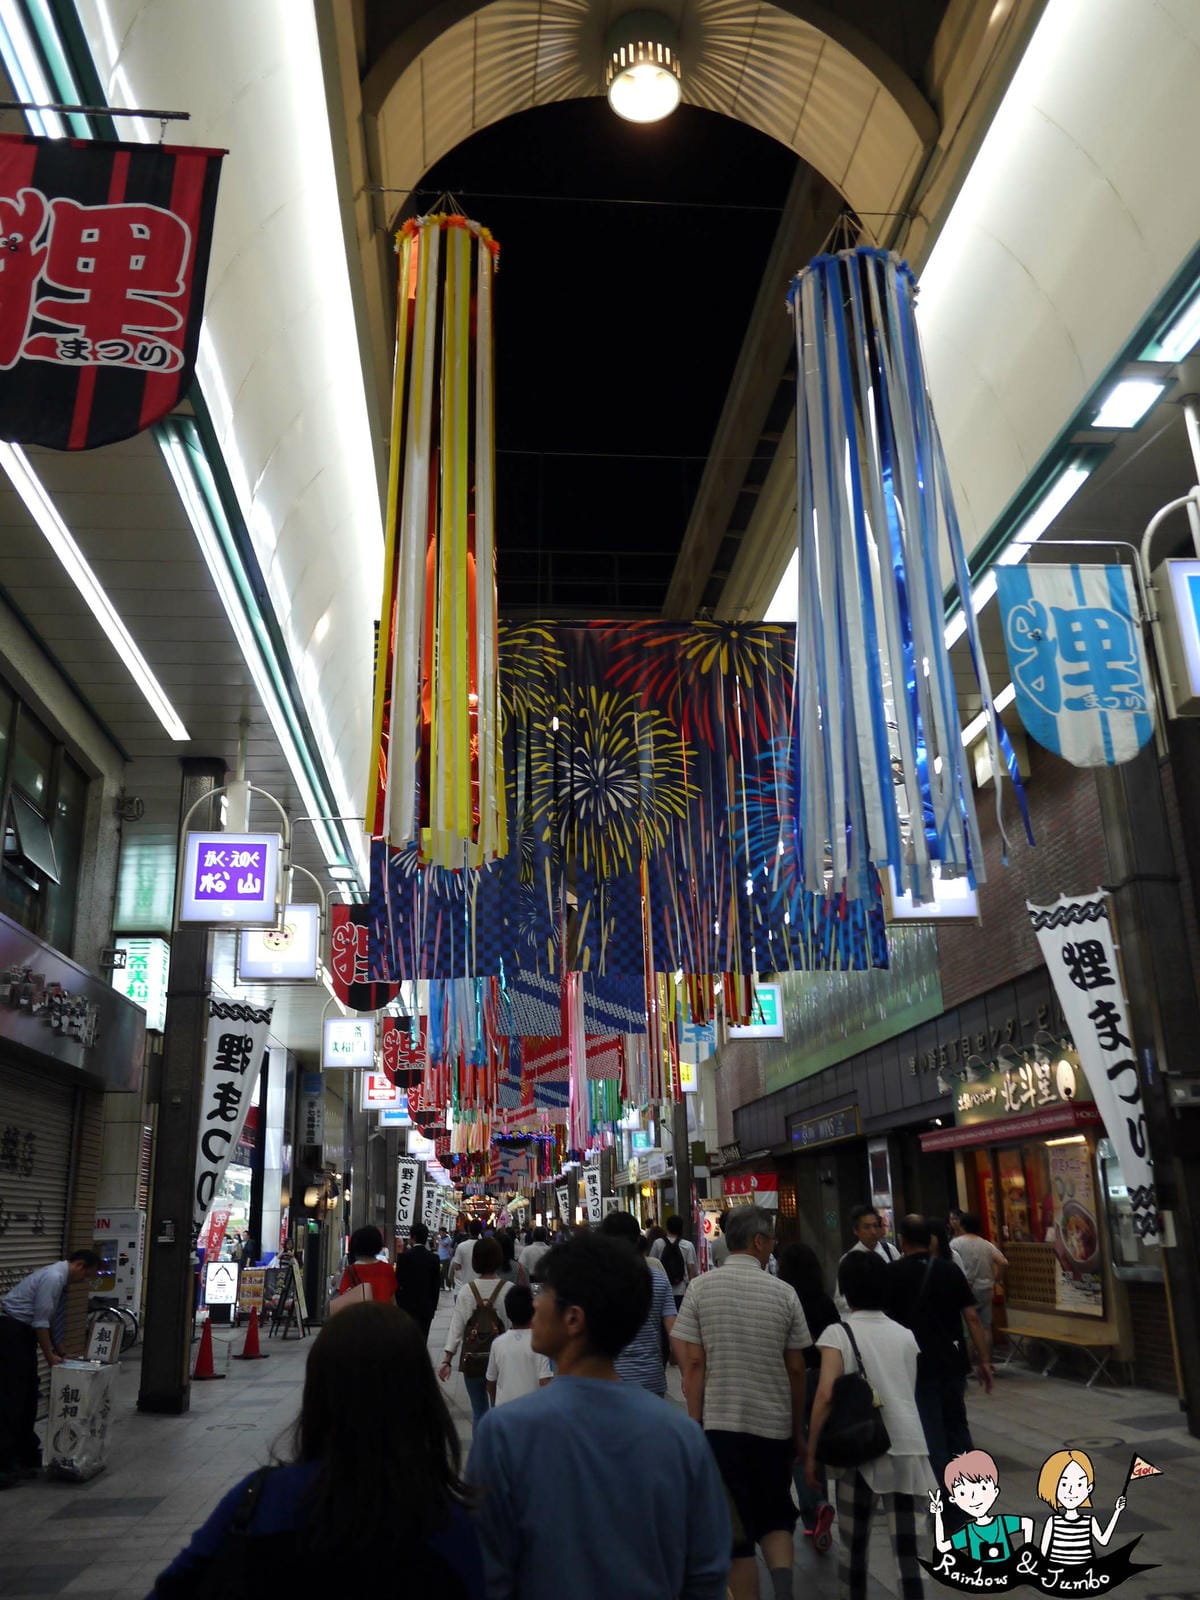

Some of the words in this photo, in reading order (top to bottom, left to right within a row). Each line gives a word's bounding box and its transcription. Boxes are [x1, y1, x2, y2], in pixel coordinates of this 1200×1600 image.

[57, 337, 170, 369] まつり
[199, 871, 261, 894] 松山
[1062, 938, 1148, 1159] 狸まつり
